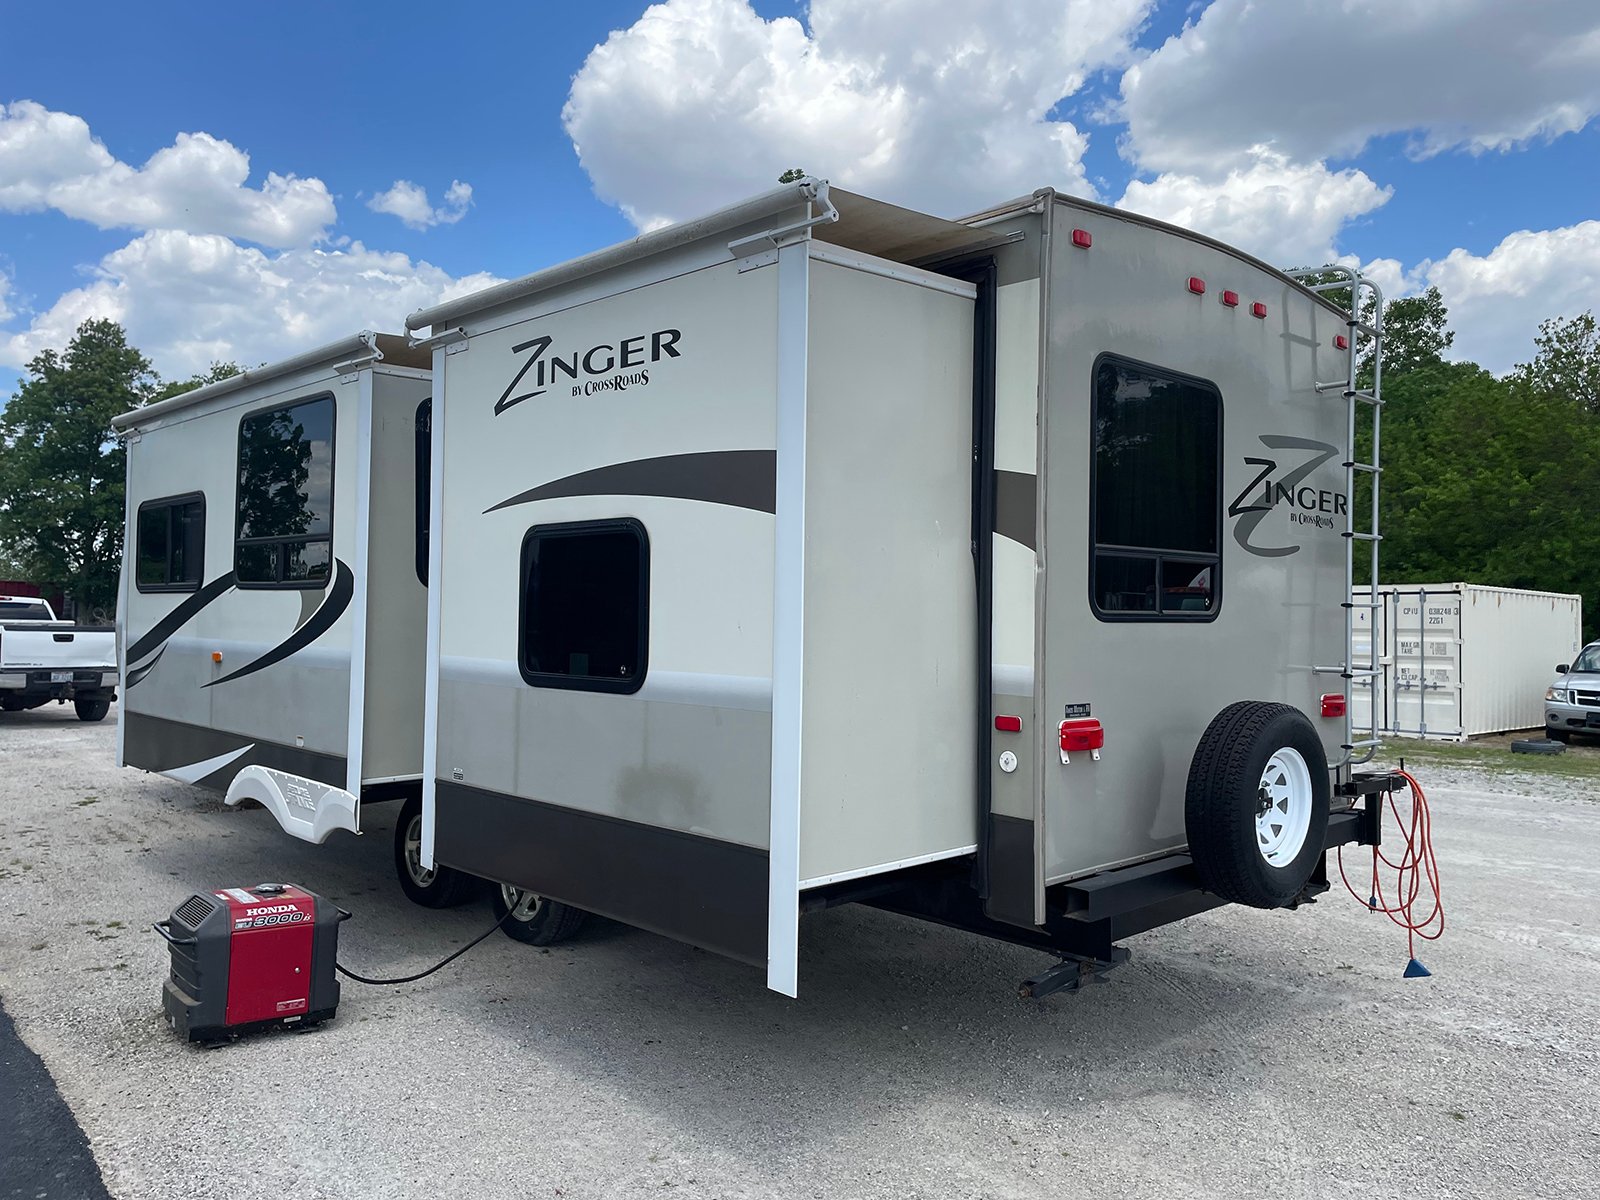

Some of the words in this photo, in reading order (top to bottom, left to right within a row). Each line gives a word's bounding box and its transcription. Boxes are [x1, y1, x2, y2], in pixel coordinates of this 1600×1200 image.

[494, 328, 682, 417] ZINGER
[572, 385, 583, 397] BY
[1228, 456, 1347, 518] ZINGER
[246, 904, 298, 917] HONDA
